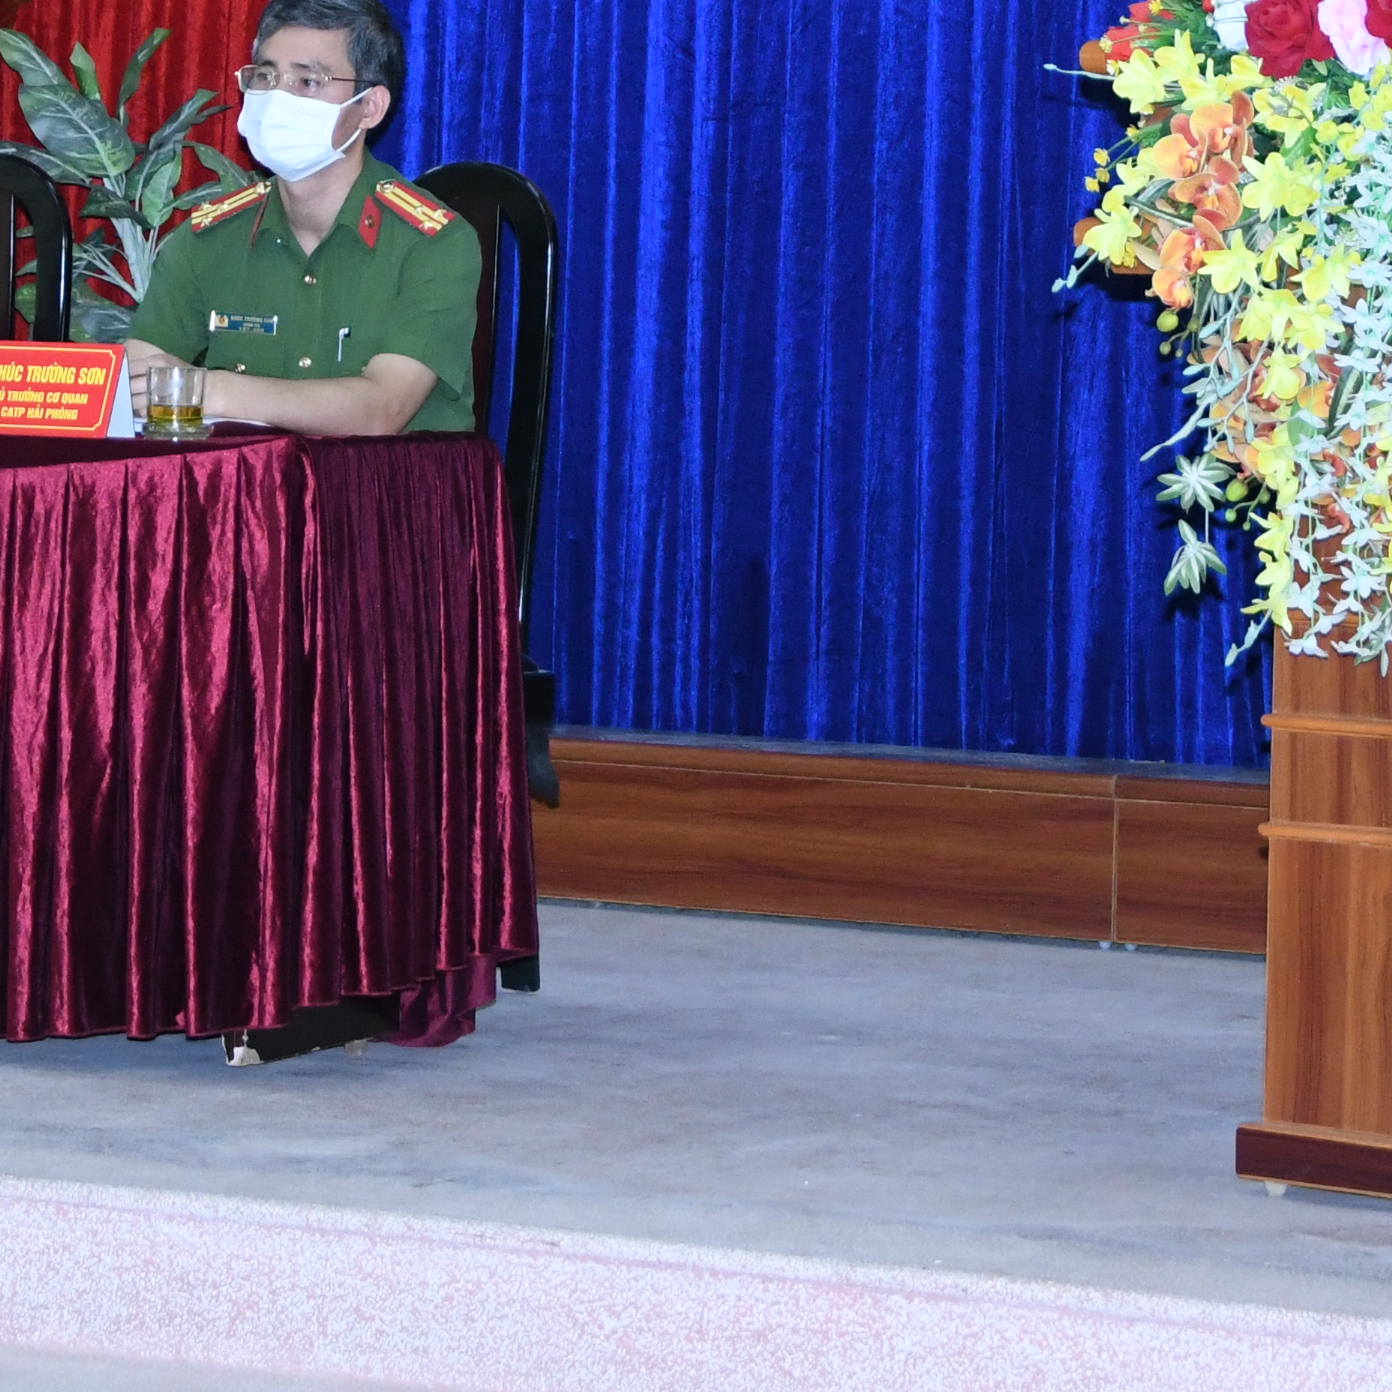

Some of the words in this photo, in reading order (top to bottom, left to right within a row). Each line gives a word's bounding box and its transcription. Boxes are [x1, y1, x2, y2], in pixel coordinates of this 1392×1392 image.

[26, 362, 77, 385] TRƯỜNG
[78, 367, 107, 386] SƠN
[46, 392, 62, 404] CƠ
[62, 393, 89, 405] QUAN
[1, 407, 26, 419] CATP
